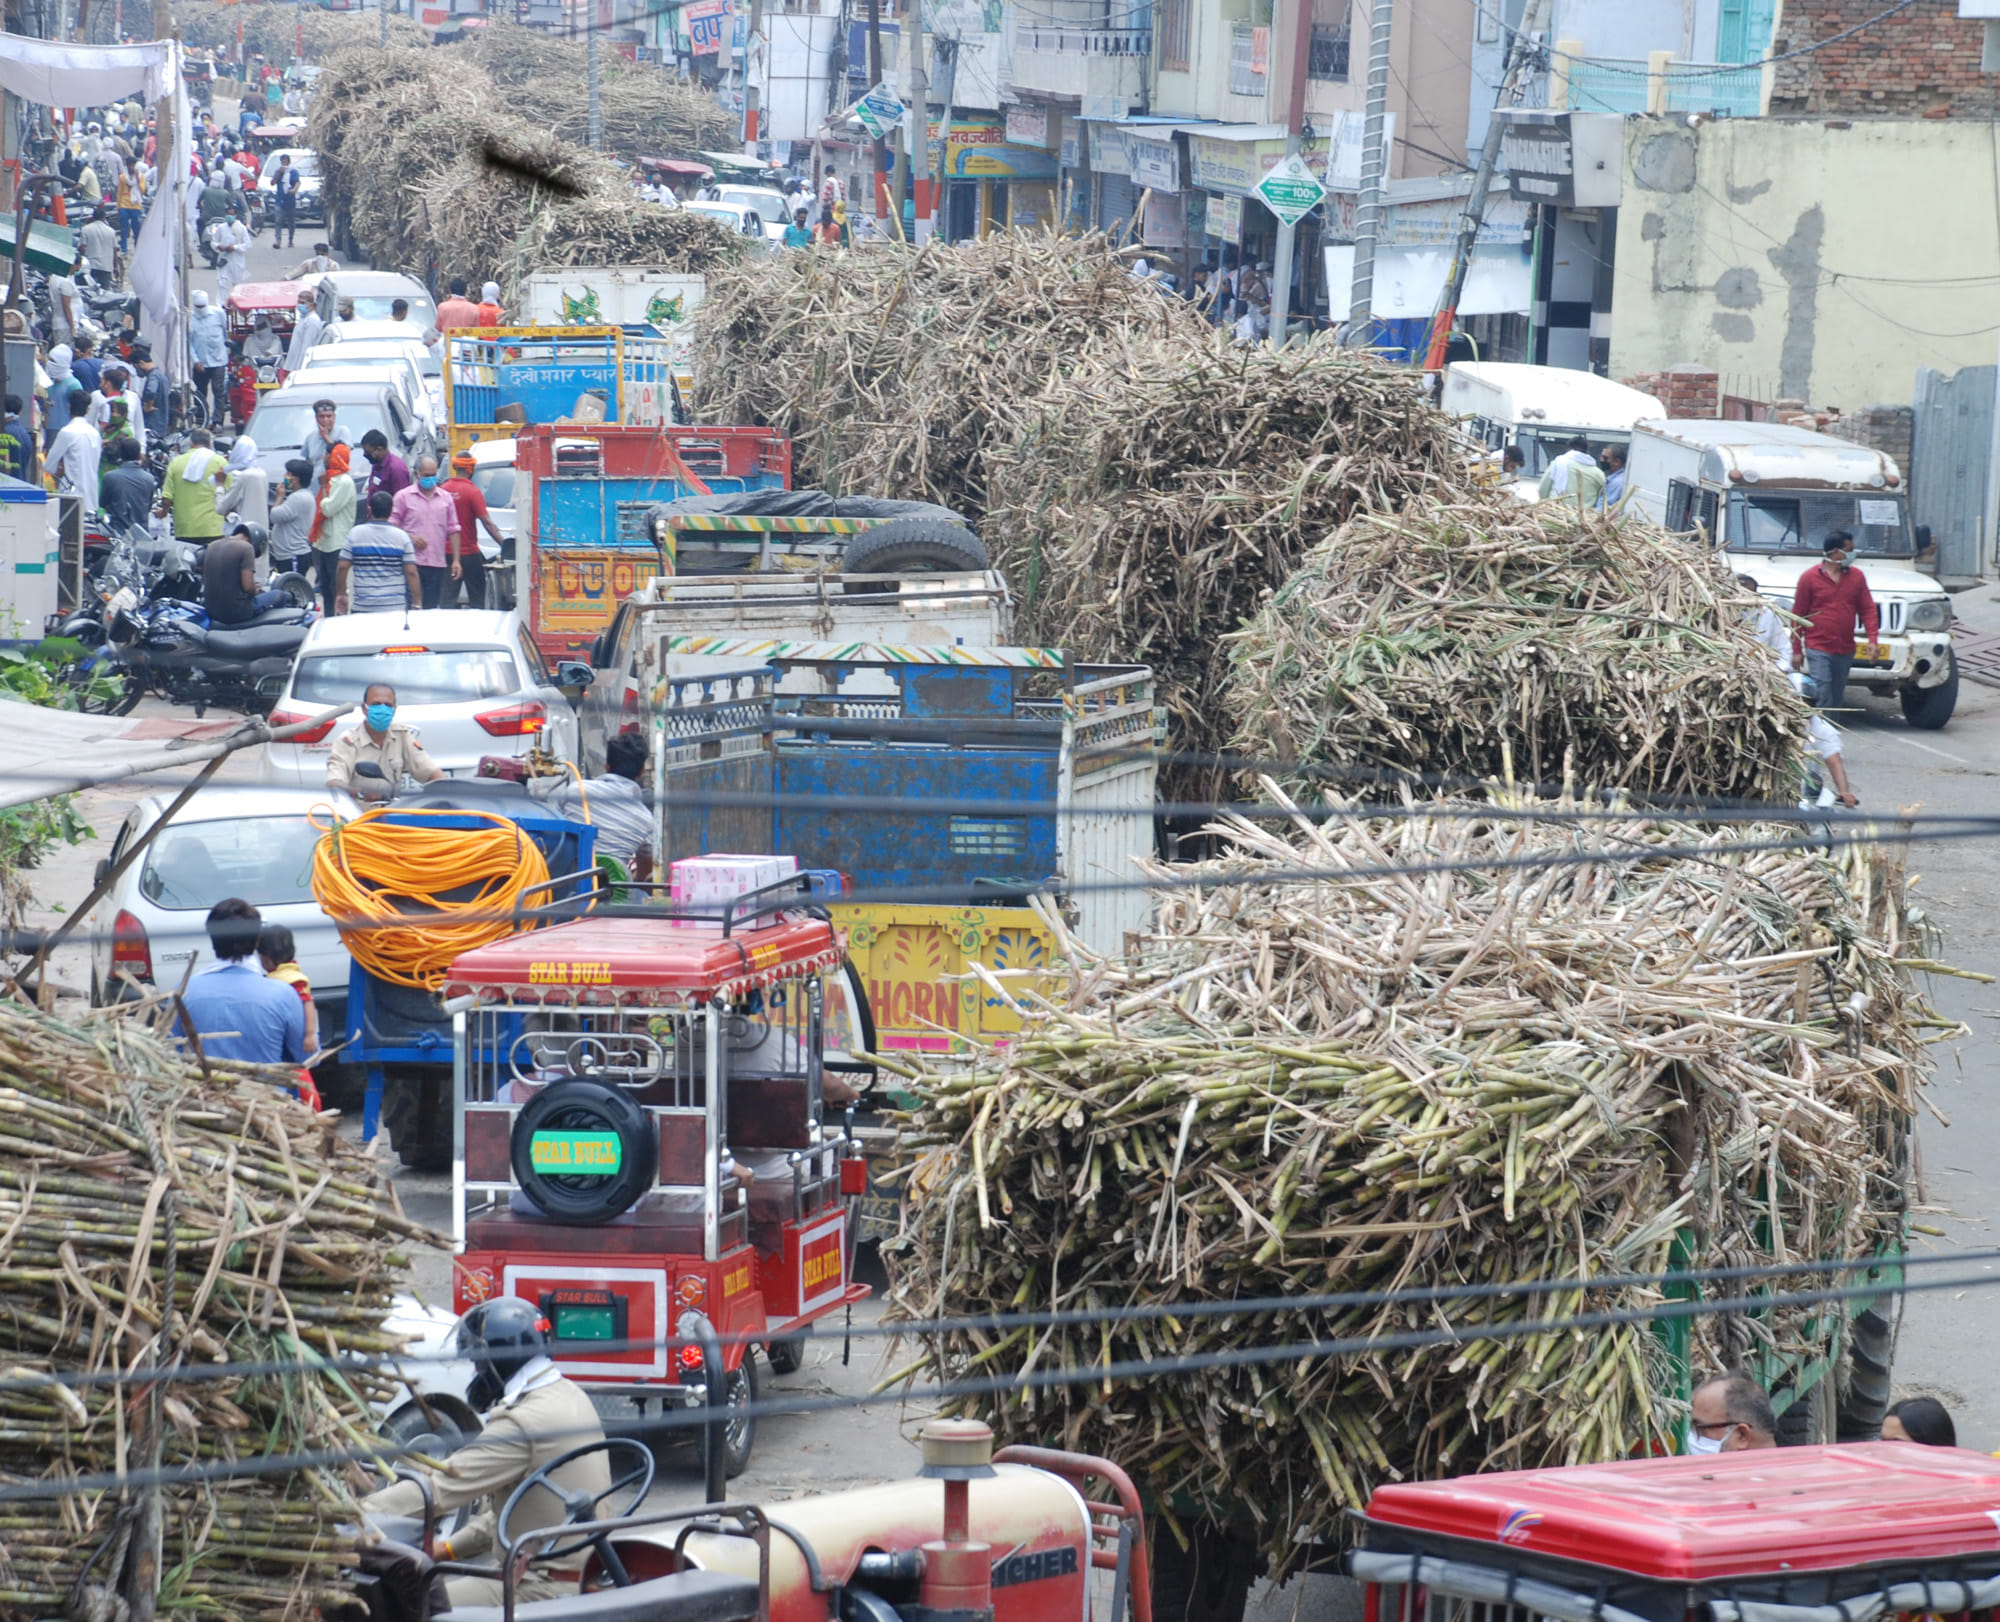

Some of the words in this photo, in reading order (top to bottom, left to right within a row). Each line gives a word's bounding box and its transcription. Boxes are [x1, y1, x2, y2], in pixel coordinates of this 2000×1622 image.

[1293, 187, 1317, 199] 100%
[510, 367, 538, 385] देखो
[541, 369, 576, 383] मगर
[529, 962, 568, 983] STAR
[571, 962, 612, 984] BULL
[870, 979, 959, 1029] HORN
[534, 1141, 571, 1164] STAR
[574, 1141, 616, 1164] BULL
[804, 1256, 823, 1289] STAR
[823, 1247, 841, 1280] BULL
[555, 1291, 582, 1304] STAR
[583, 1291, 608, 1304] BULL
